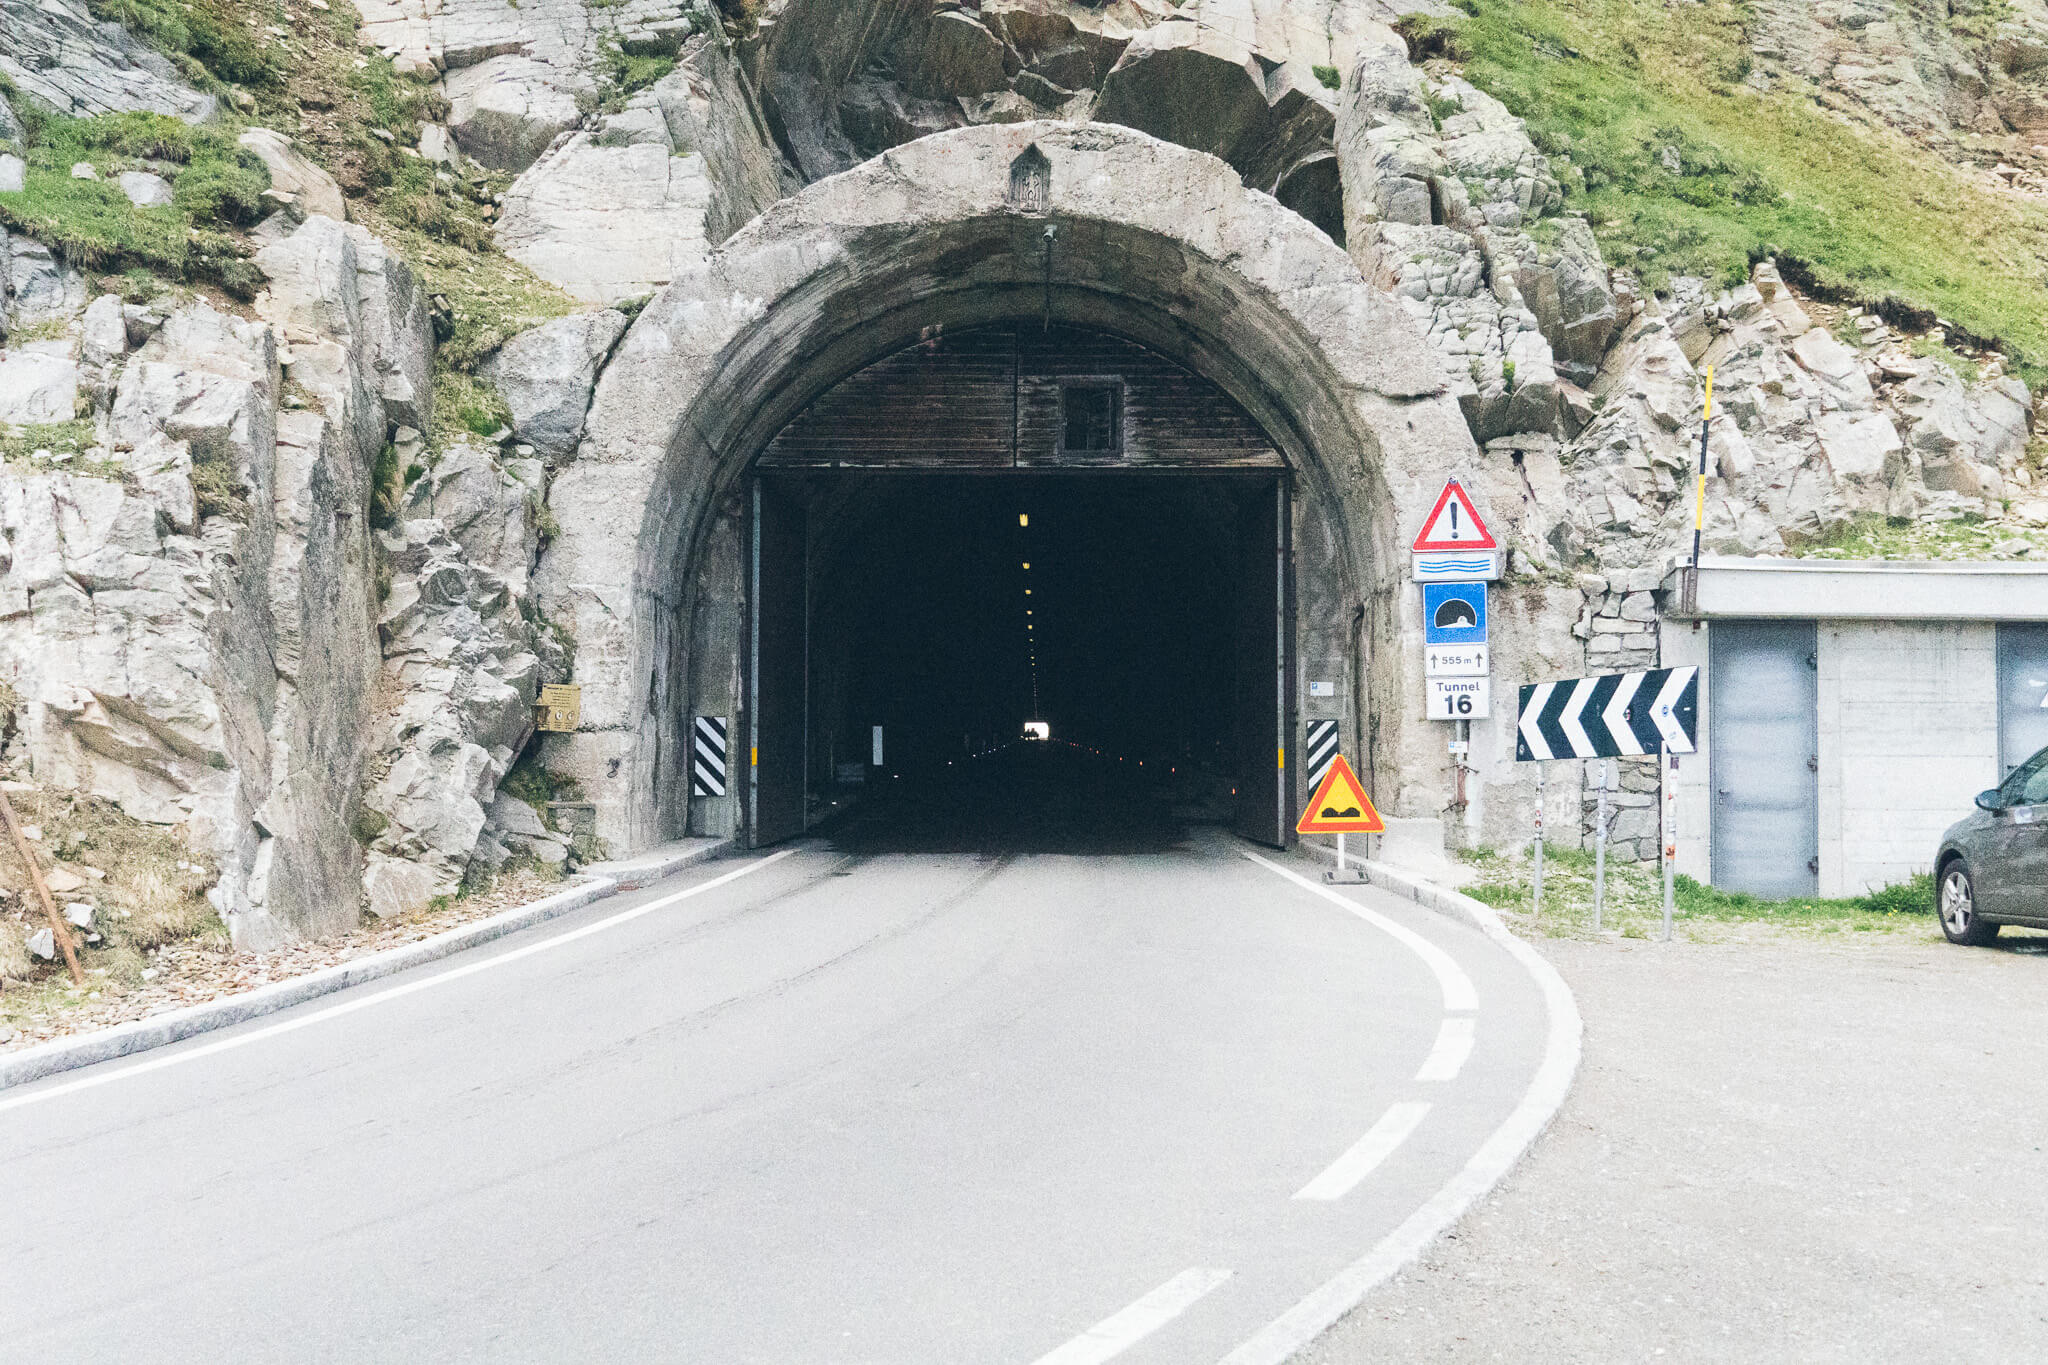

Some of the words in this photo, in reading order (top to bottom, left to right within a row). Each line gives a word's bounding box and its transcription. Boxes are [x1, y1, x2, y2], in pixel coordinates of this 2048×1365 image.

[1442, 656, 1462, 664] 555
[1436, 682, 1480, 692] Tunnel
[1444, 694, 1472, 714] 16
